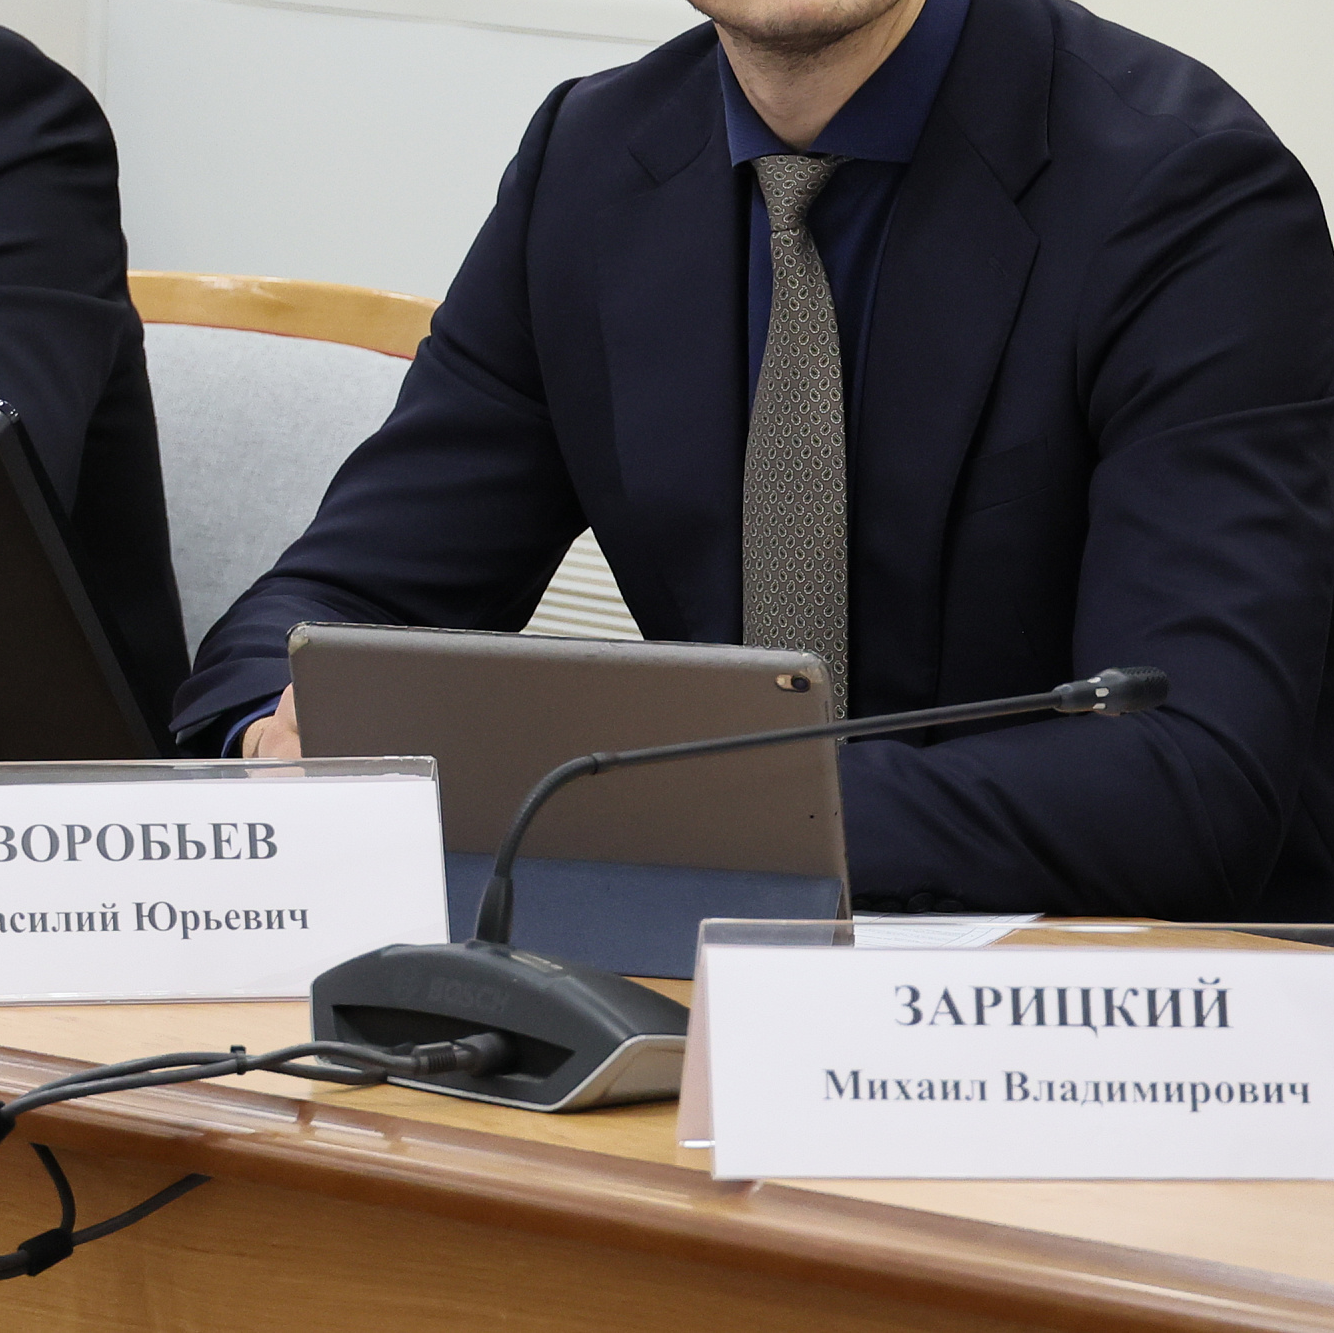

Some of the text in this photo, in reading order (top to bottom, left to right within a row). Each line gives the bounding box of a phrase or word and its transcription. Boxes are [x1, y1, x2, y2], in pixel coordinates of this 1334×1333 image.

[134, 901, 309, 940] Юрьевич
[894, 977, 1232, 1036] ЗАРИЦКИЙ
[825, 1069, 1311, 1113] Михаил Владимирович
